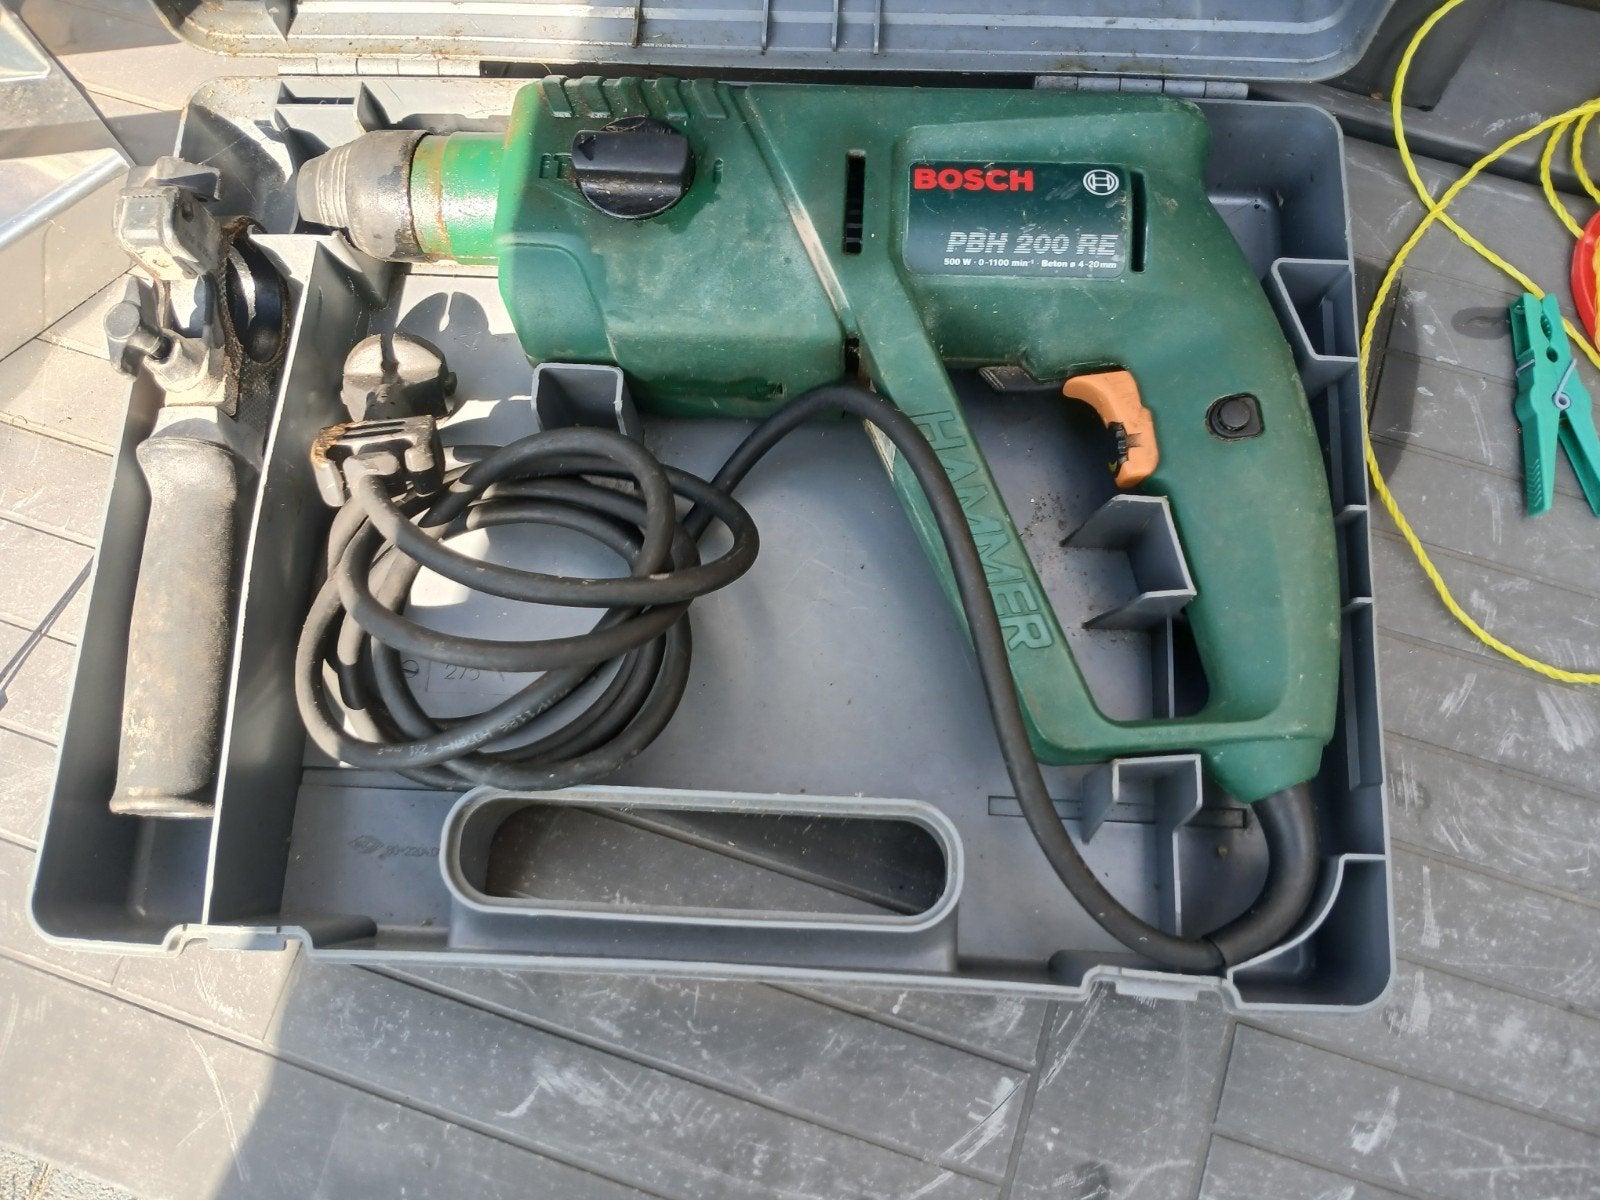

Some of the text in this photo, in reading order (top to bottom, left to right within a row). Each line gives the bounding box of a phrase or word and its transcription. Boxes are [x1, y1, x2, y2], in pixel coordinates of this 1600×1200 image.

[913, 168, 1035, 192] BOSCH
[946, 231, 1119, 256] PBH 200 RE
[943, 257, 961, 266] 500
[962, 257, 972, 266] W
[1041, 259, 1068, 268] Beton
[909, 409, 1055, 652] HAMMER
